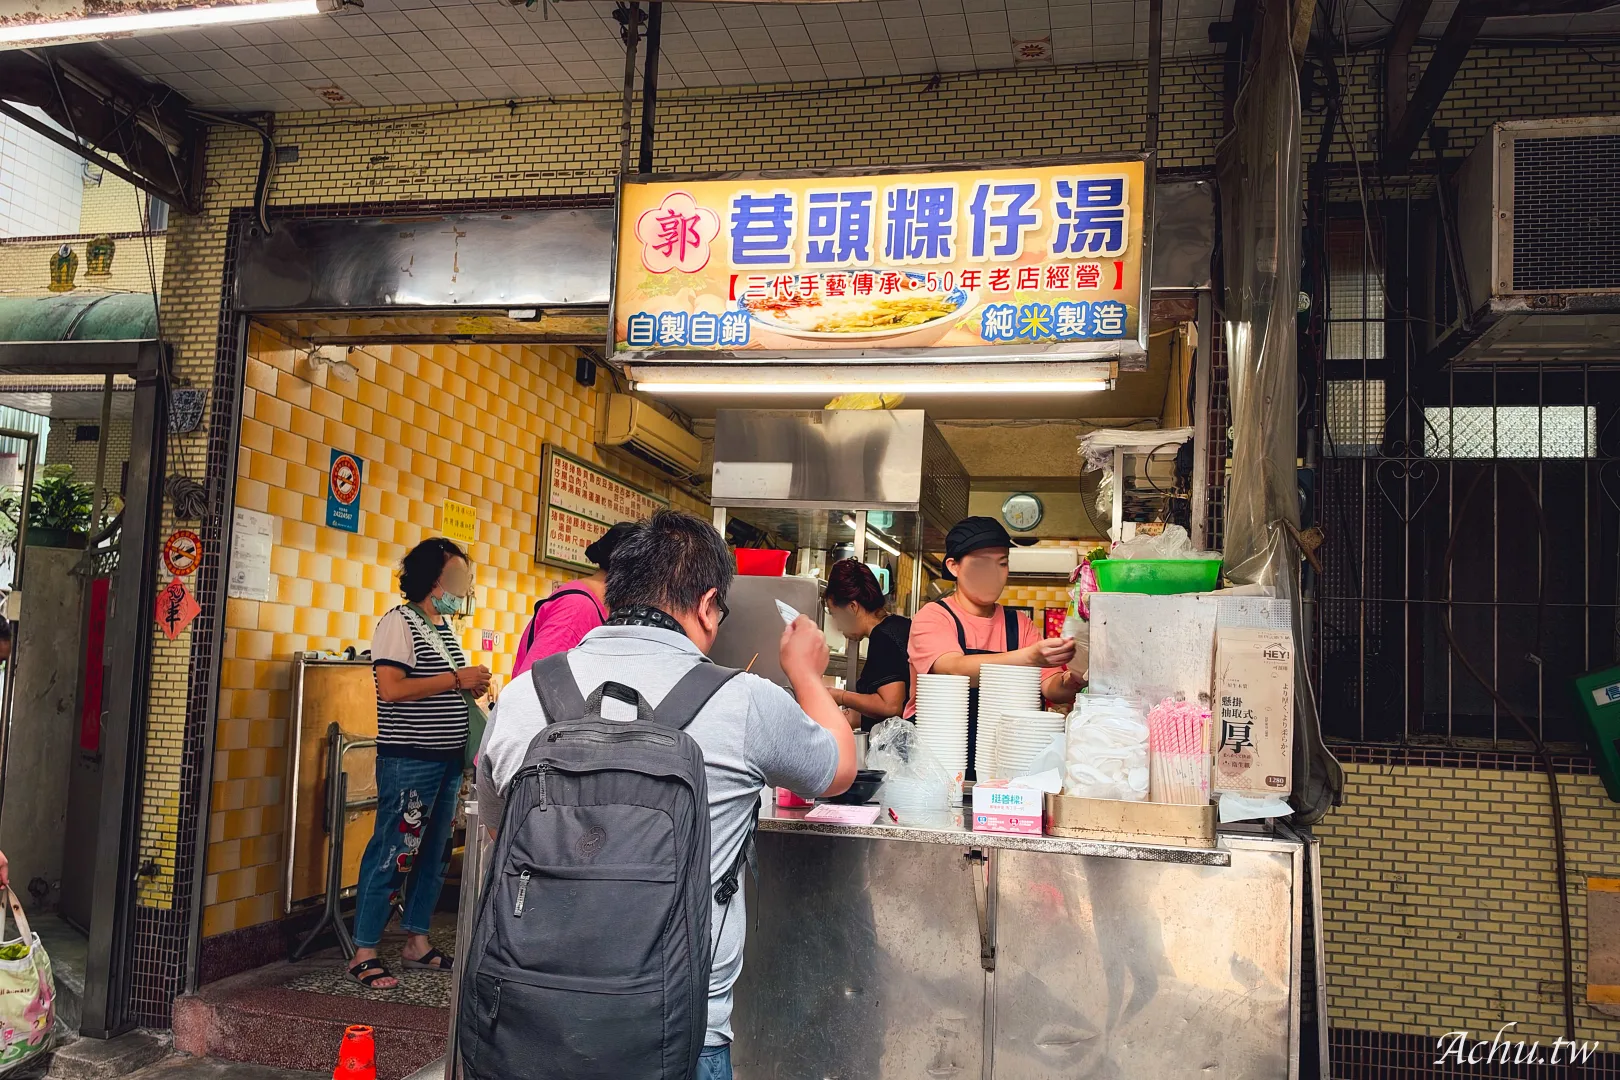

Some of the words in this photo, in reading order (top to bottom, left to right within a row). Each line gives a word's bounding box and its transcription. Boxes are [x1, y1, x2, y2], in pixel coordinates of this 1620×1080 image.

[653, 208, 701, 260] 郭
[728, 178, 1128, 265] 巷頭粿仔湯
[628, 312, 750, 345] 自製自銷
[983, 302, 1127, 341] 純米製造
[1263, 650, 1290, 659] HEY!
[1222, 696, 1243, 707] 懸掛
[1218, 719, 1254, 753] 厚
